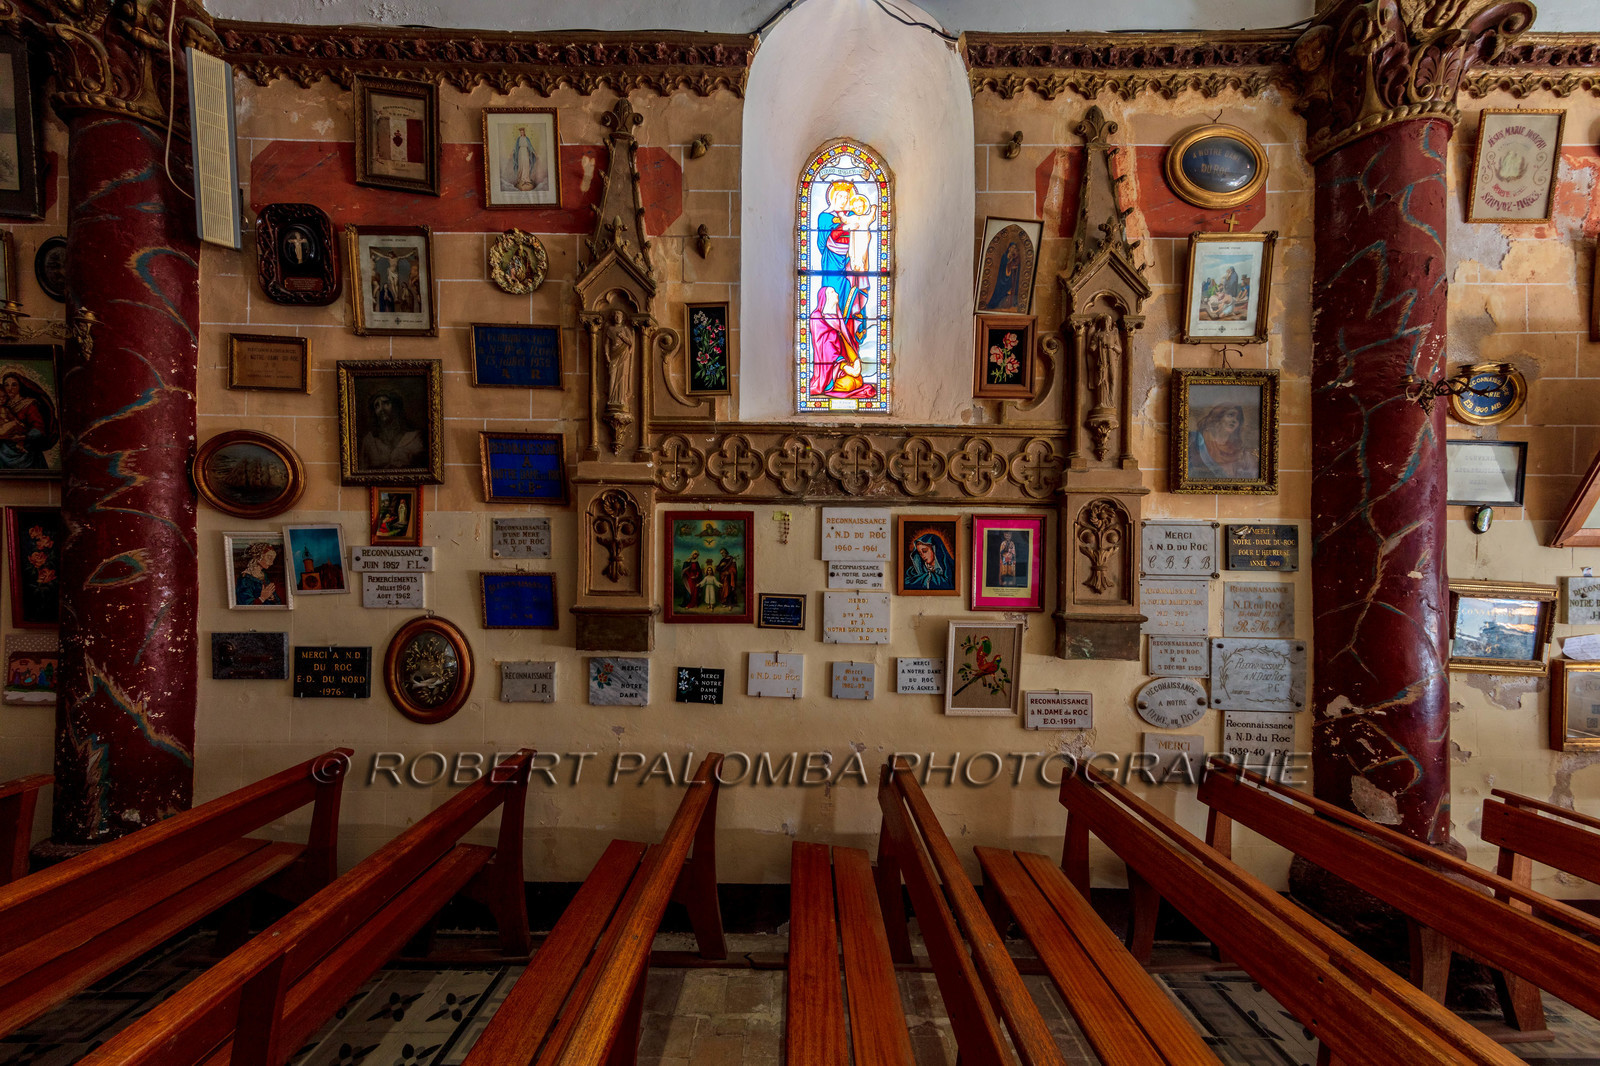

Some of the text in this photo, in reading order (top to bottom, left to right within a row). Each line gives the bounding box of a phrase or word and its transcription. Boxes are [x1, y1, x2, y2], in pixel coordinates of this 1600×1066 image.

[1198, 148, 1222, 156] NOTRE
[1200, 163, 1212, 174] DU
[869, 531, 887, 539] ROC
[1165, 531, 1192, 539] MERCI
[1190, 542, 1208, 551] ROC
[362, 549, 424, 557] RECONNAISSANCE
[362, 561, 380, 570] JUIN
[368, 575, 418, 583] REMERCIEMENTS
[1230, 586, 1288, 594] RECONNAISSANCE
[1265, 600, 1285, 610] ROC
[1570, 600, 1594, 608] NOTRE
[302, 652, 328, 660] MERCI
[314, 664, 352, 672] DU ROC
[322, 675, 335, 683] DU
[342, 676, 366, 684] NORD
[1226, 720, 1293, 730] Reconnaissance
[1258, 733, 1268, 741] du
[1271, 734, 1291, 742] Roc
[1158, 741, 1190, 751] MERCI
